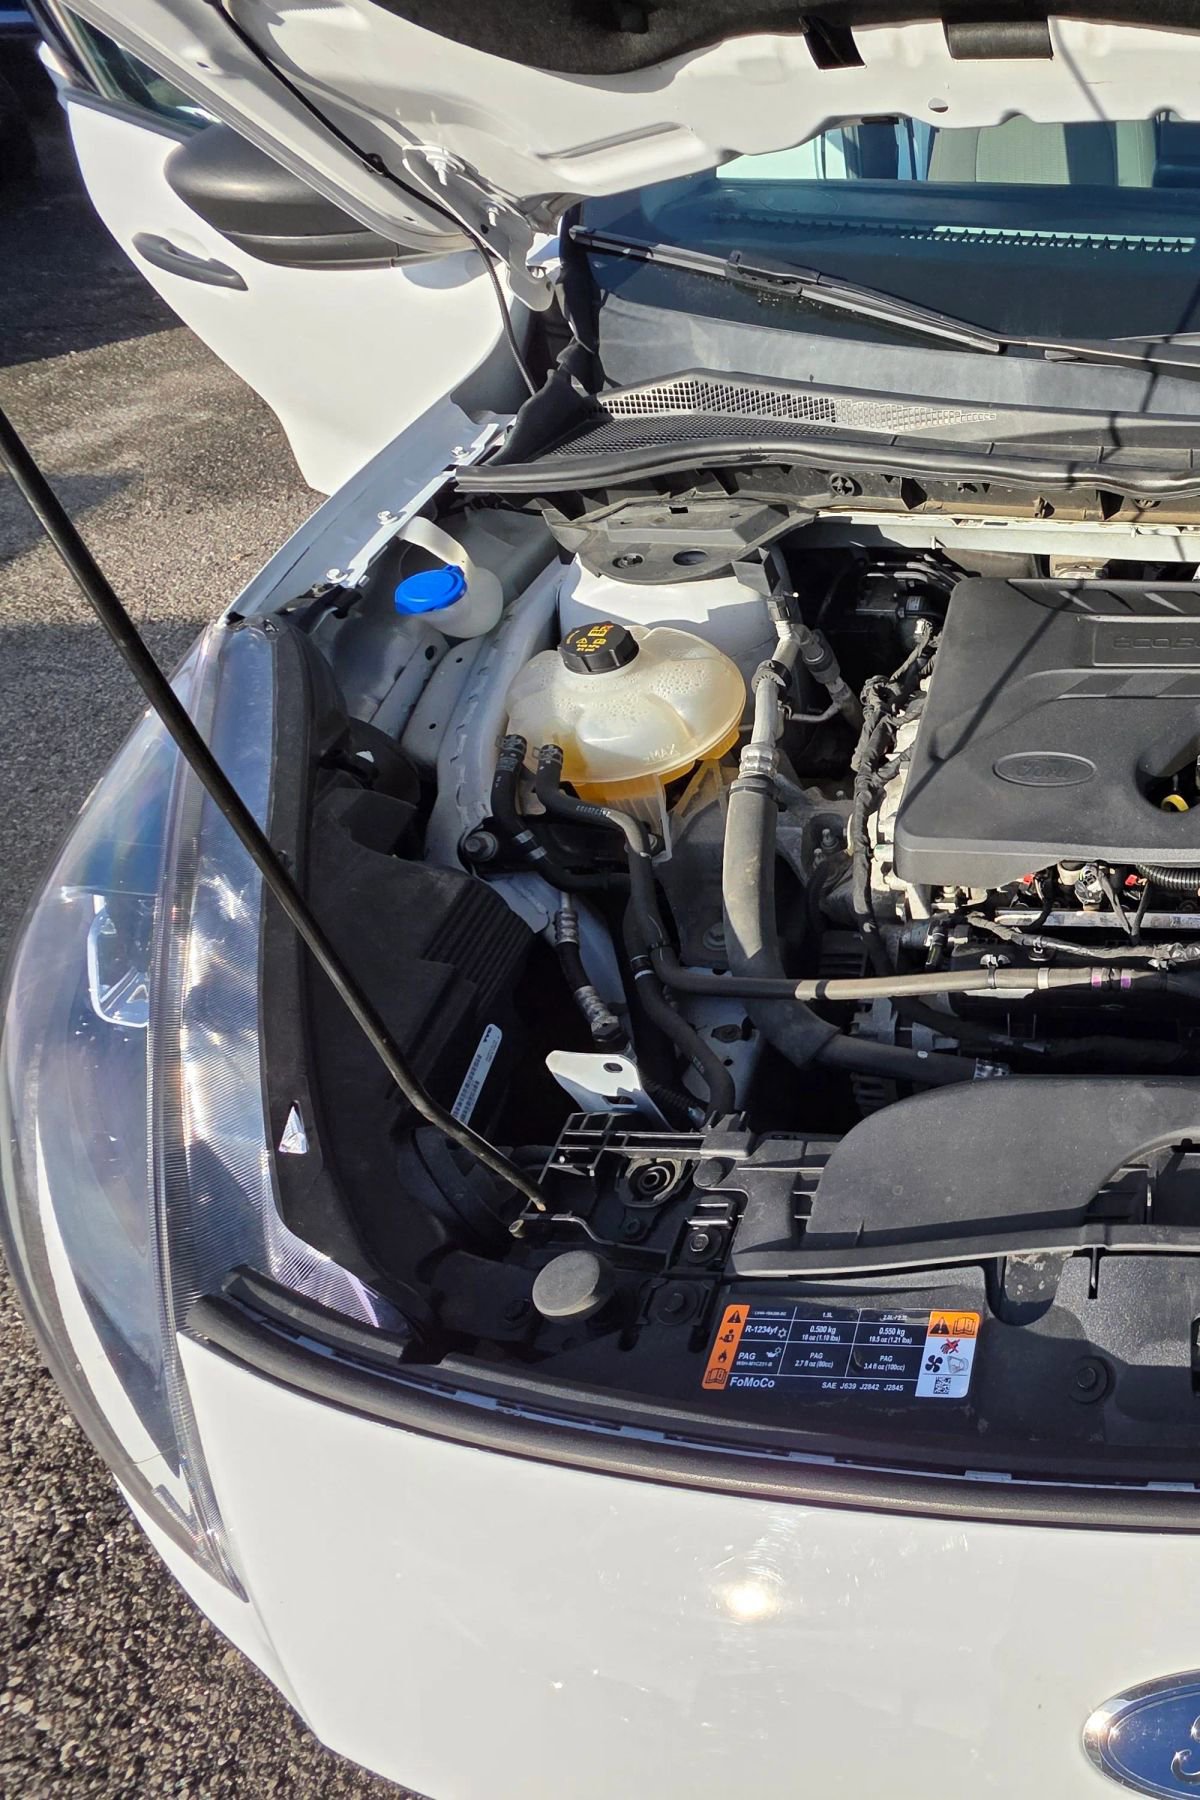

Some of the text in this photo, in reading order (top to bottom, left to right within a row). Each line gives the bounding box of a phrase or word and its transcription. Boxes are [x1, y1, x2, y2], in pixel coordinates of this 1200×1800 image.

[745, 1325, 778, 1336] R-1234yf
[810, 1325, 836, 1335] 0.500 kg
[879, 1327, 906, 1337] 0.550 kg
[738, 1352, 756, 1360] PAG
[730, 1376, 775, 1388] FoMoCo
[822, 1382, 837, 1390] SAE
[860, 1383, 880, 1391] J2842
[883, 1384, 904, 1392] J2845
